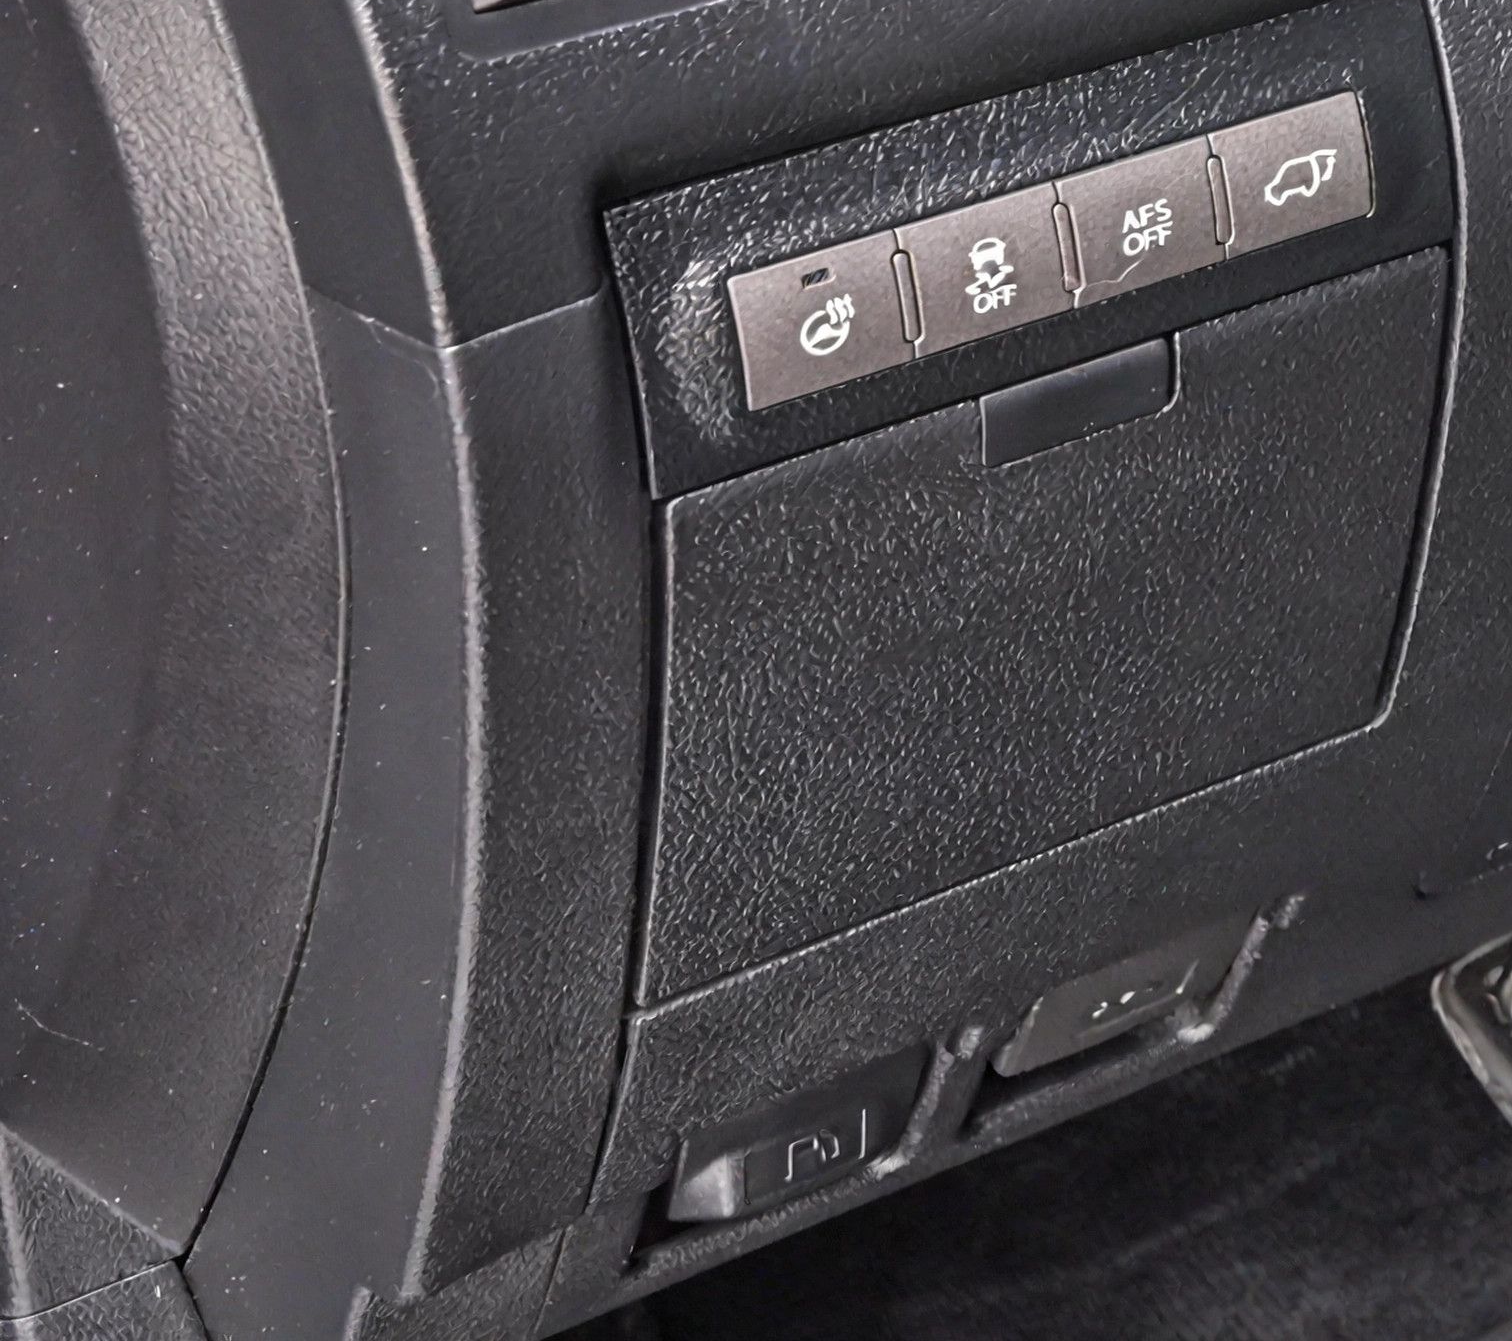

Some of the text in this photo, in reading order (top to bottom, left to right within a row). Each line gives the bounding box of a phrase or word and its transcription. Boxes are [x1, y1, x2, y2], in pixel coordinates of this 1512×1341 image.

[1122, 198, 1174, 234] AFS
[1123, 221, 1174, 256] OFF
[973, 284, 1017, 314] OFF
